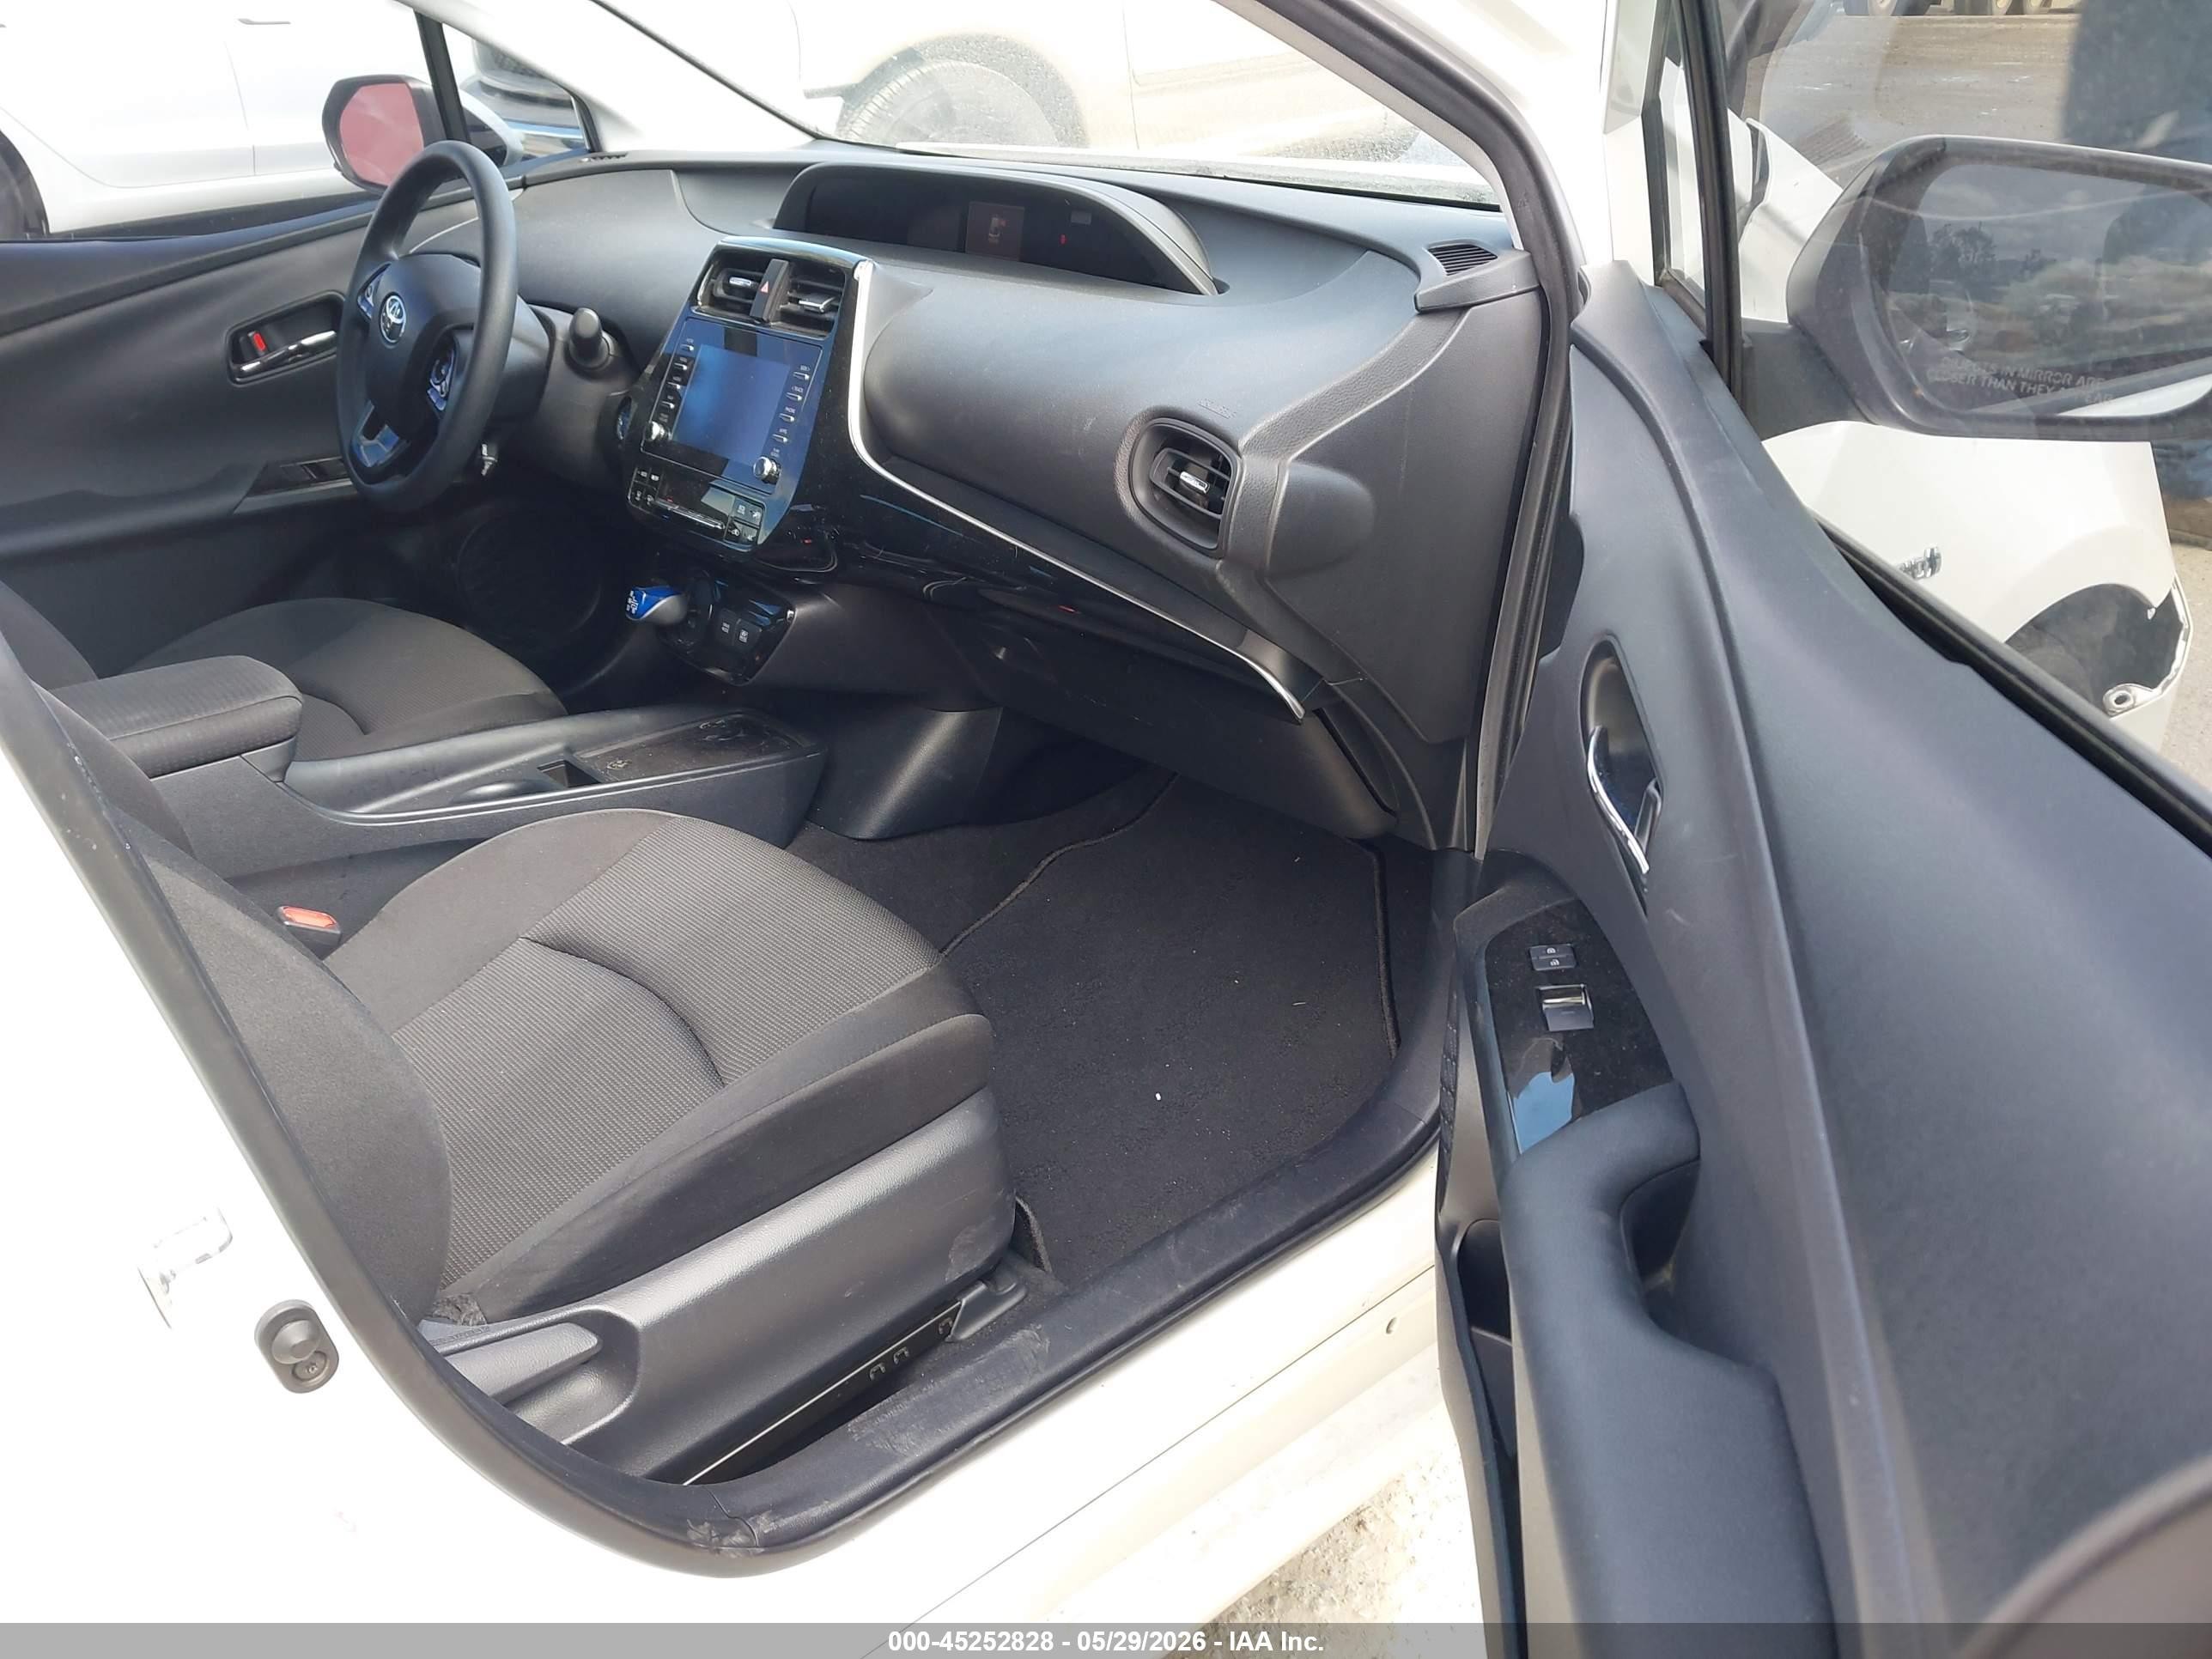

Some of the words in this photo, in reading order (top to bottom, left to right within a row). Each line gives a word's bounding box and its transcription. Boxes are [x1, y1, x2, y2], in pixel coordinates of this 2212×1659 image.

[1978, 375, 2018, 391] THAN
[2020, 380, 2055, 395] THEY
[2016, 367, 2073, 385] MIRROR
